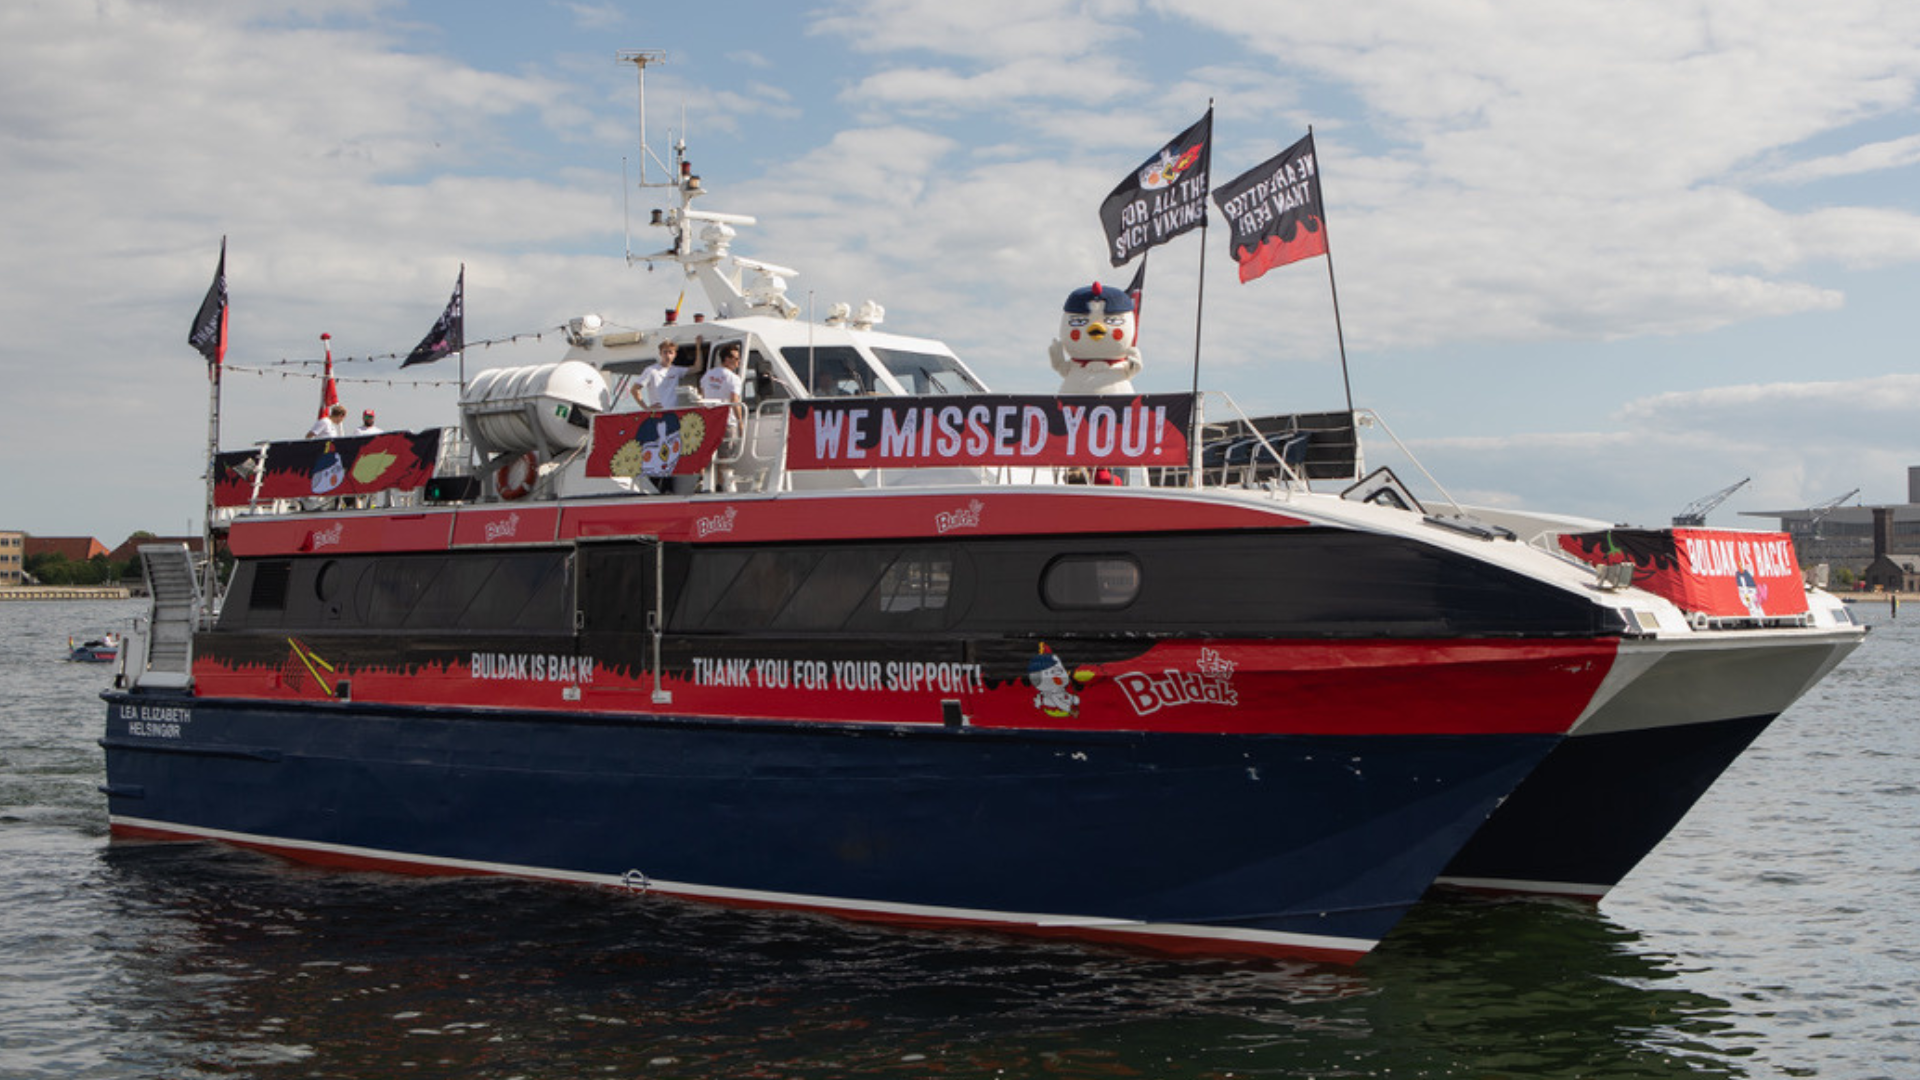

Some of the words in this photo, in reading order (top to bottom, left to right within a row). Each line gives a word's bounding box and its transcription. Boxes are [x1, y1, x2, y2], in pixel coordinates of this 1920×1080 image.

[1121, 200, 1148, 230] FOR
[1152, 187, 1177, 216] ALL
[1180, 171, 1206, 202] THE
[1115, 222, 1150, 258] SICY
[814, 409, 868, 459] WE
[880, 405, 1049, 457] MISSED
[1062, 405, 1166, 457] YOU!
[1685, 538, 1738, 577] BULDAK
[1737, 541, 1755, 577] IS
[1752, 541, 1792, 577] BACK!
[471, 652, 528, 680] BULDAK
[531, 653, 546, 681] IS
[547, 654, 593, 683] BACK!
[692, 657, 751, 687] THANK
[754, 658, 789, 689] YOU
[793, 660, 829, 690] FOR
[832, 660, 882, 692] YOUR
[885, 661, 985, 694] SUPPORT!
[1114, 669, 1239, 716] Buldak
[120, 704, 139, 719] LEA
[141, 705, 191, 722] ELIZABETH
[128, 721, 181, 738] HELSINGØR
